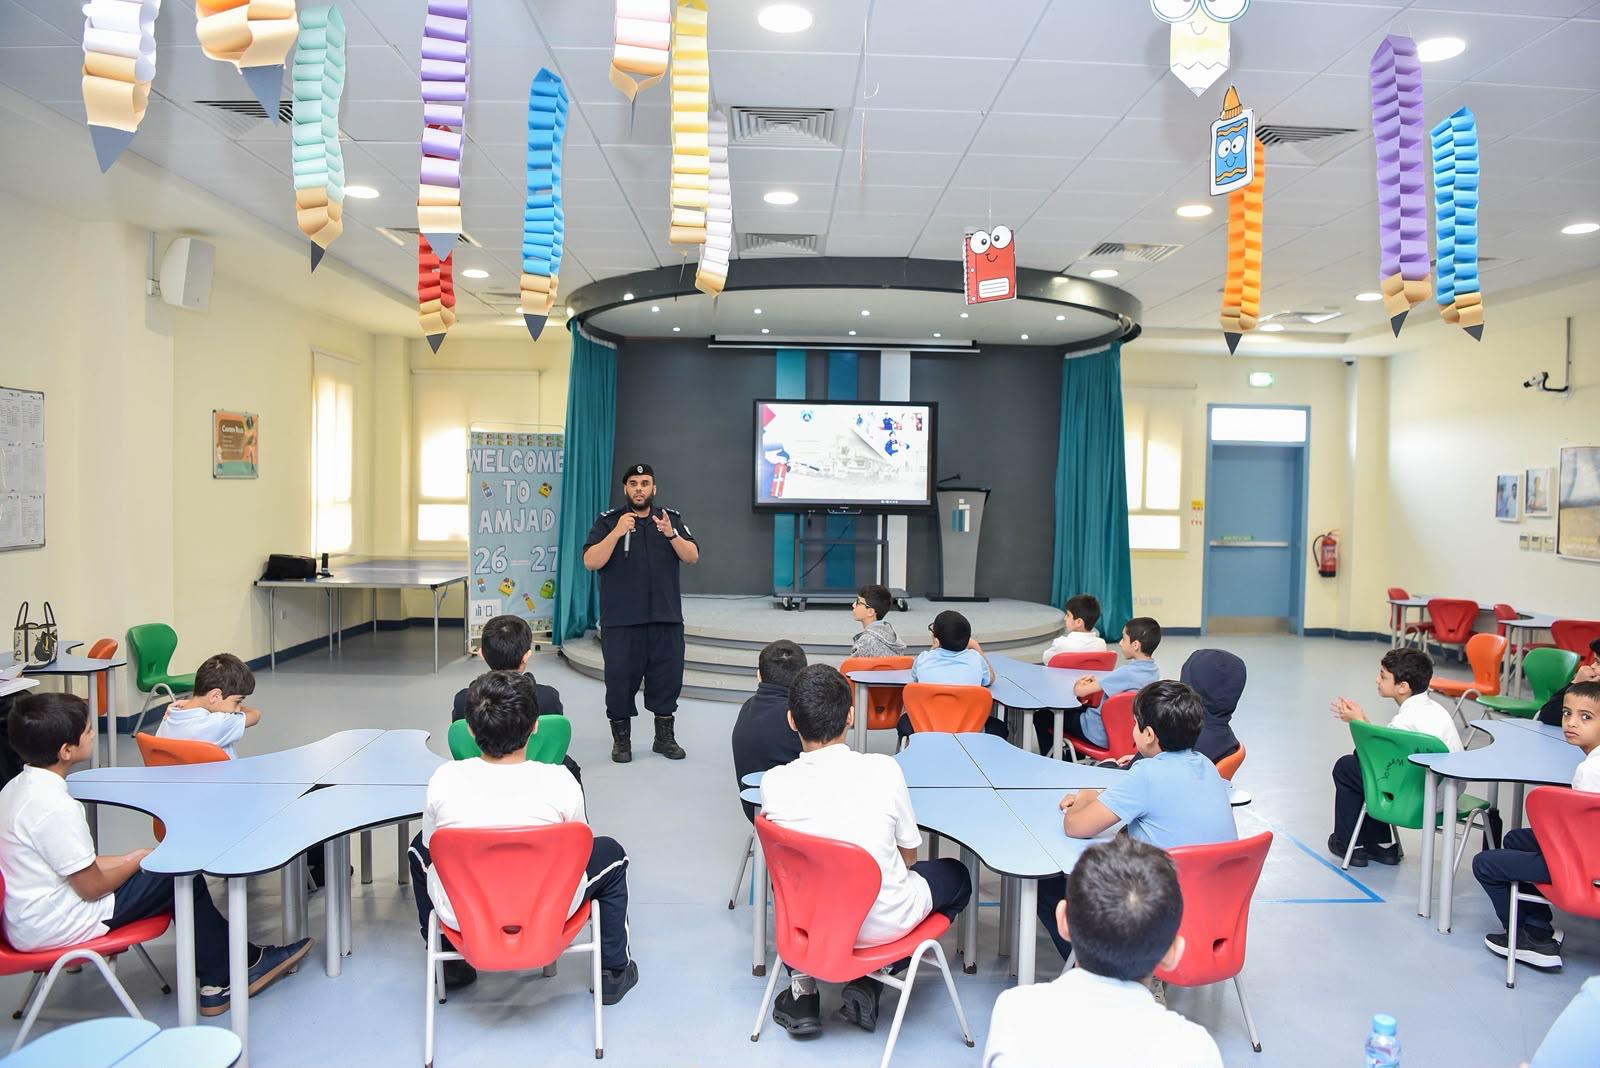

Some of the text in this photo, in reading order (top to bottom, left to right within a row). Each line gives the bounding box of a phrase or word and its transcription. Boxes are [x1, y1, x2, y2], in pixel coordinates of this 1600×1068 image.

[466, 448, 564, 473] WELCOME
[503, 479, 530, 504] TO
[477, 508, 556, 534] AMJAD
